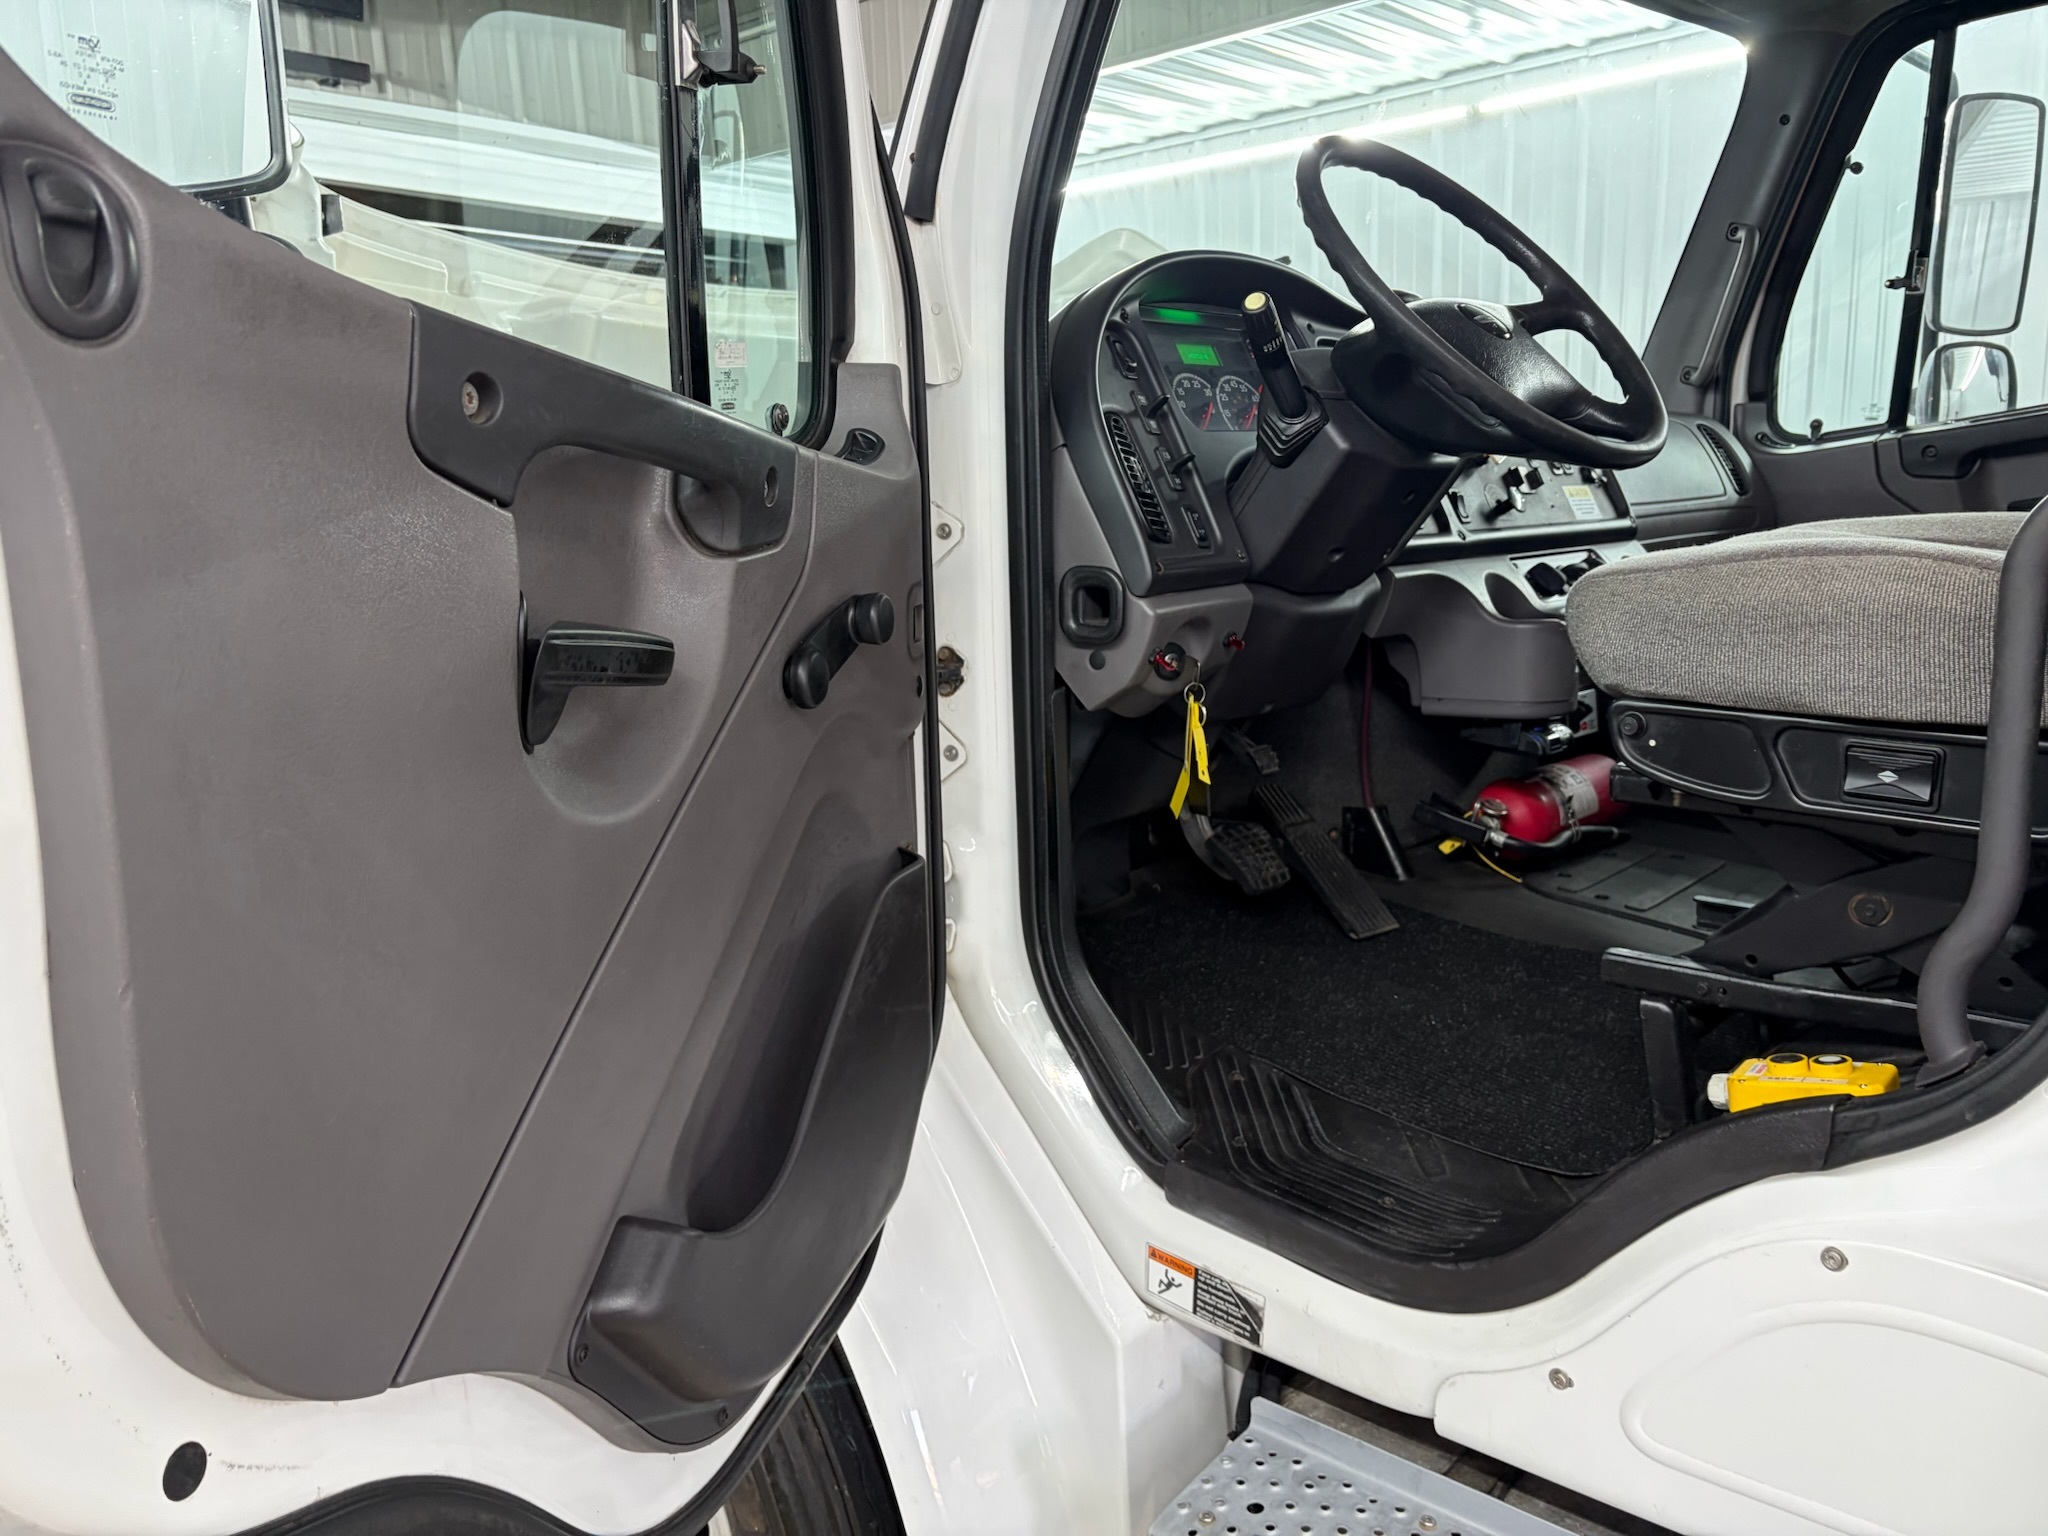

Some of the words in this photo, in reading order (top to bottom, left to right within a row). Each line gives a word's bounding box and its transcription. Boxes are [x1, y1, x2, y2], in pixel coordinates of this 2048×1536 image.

[1192, 380, 1201, 388] 25
[1230, 380, 1238, 389] 45
[1177, 386, 1186, 395] 15
[1220, 393, 1229, 401] 25
[1157, 1252, 1193, 1275] WARNING
